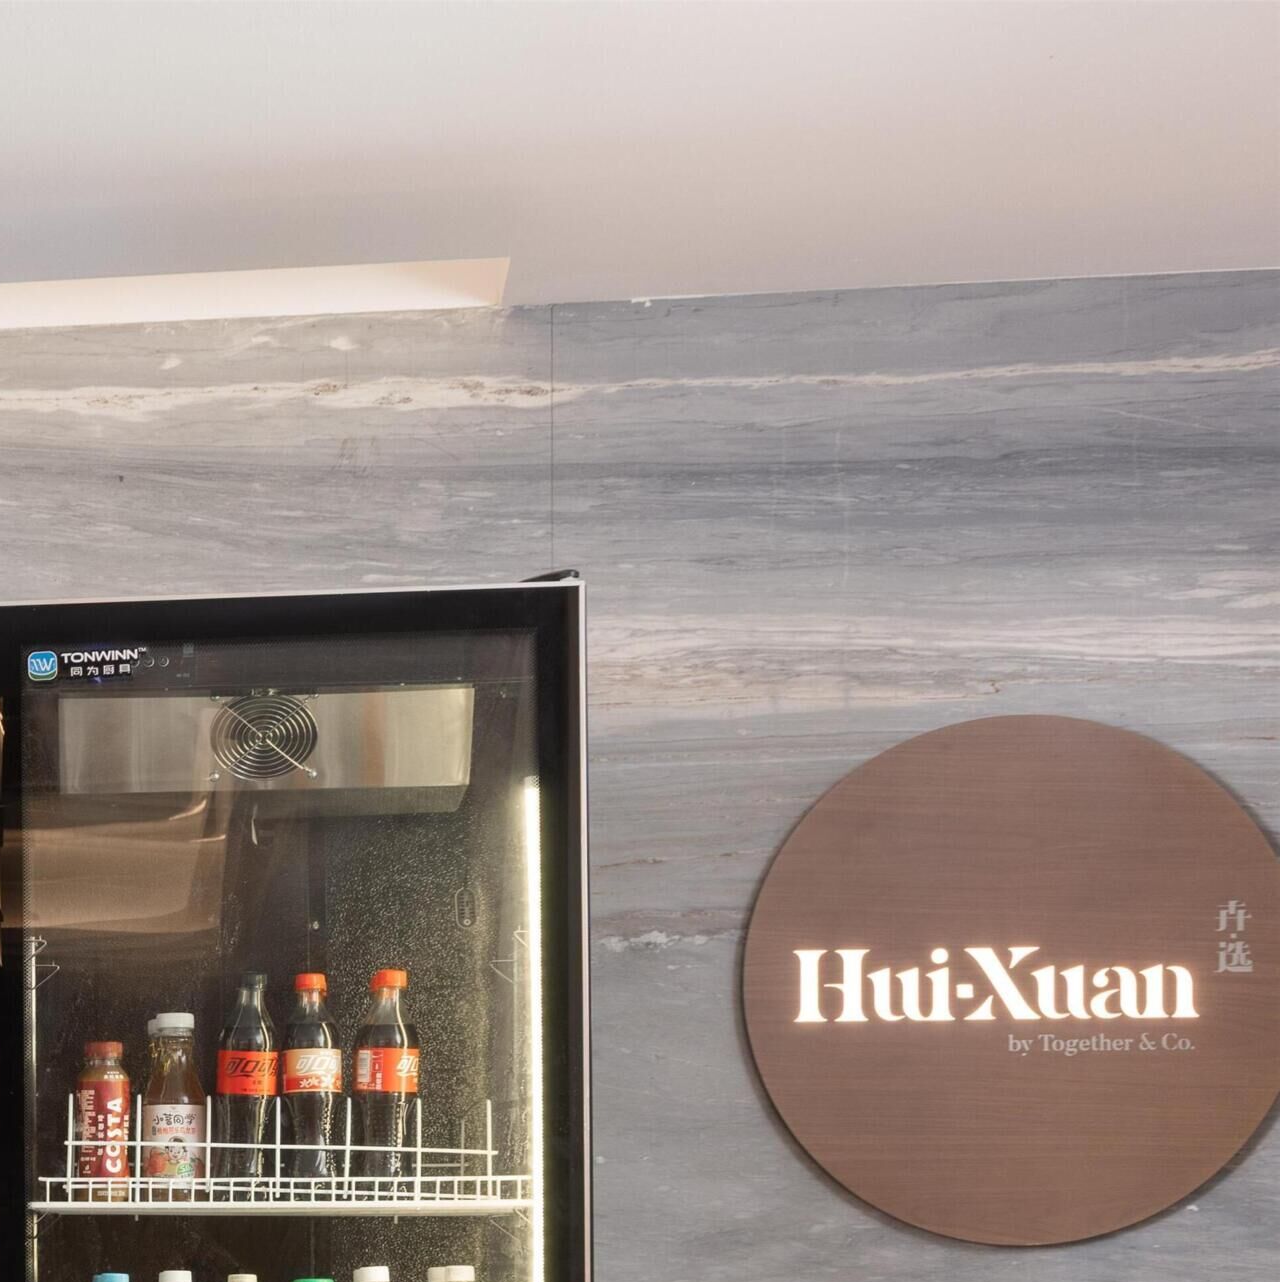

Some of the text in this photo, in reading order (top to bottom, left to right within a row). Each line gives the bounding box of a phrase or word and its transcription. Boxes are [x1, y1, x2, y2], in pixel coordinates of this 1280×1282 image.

[61, 649, 138, 664] TONWINN
[70, 664, 131, 677] 同为厨具
[1008, 1033, 1196, 1056] by Together & Co.
[105, 1098, 123, 1173] COSTA
